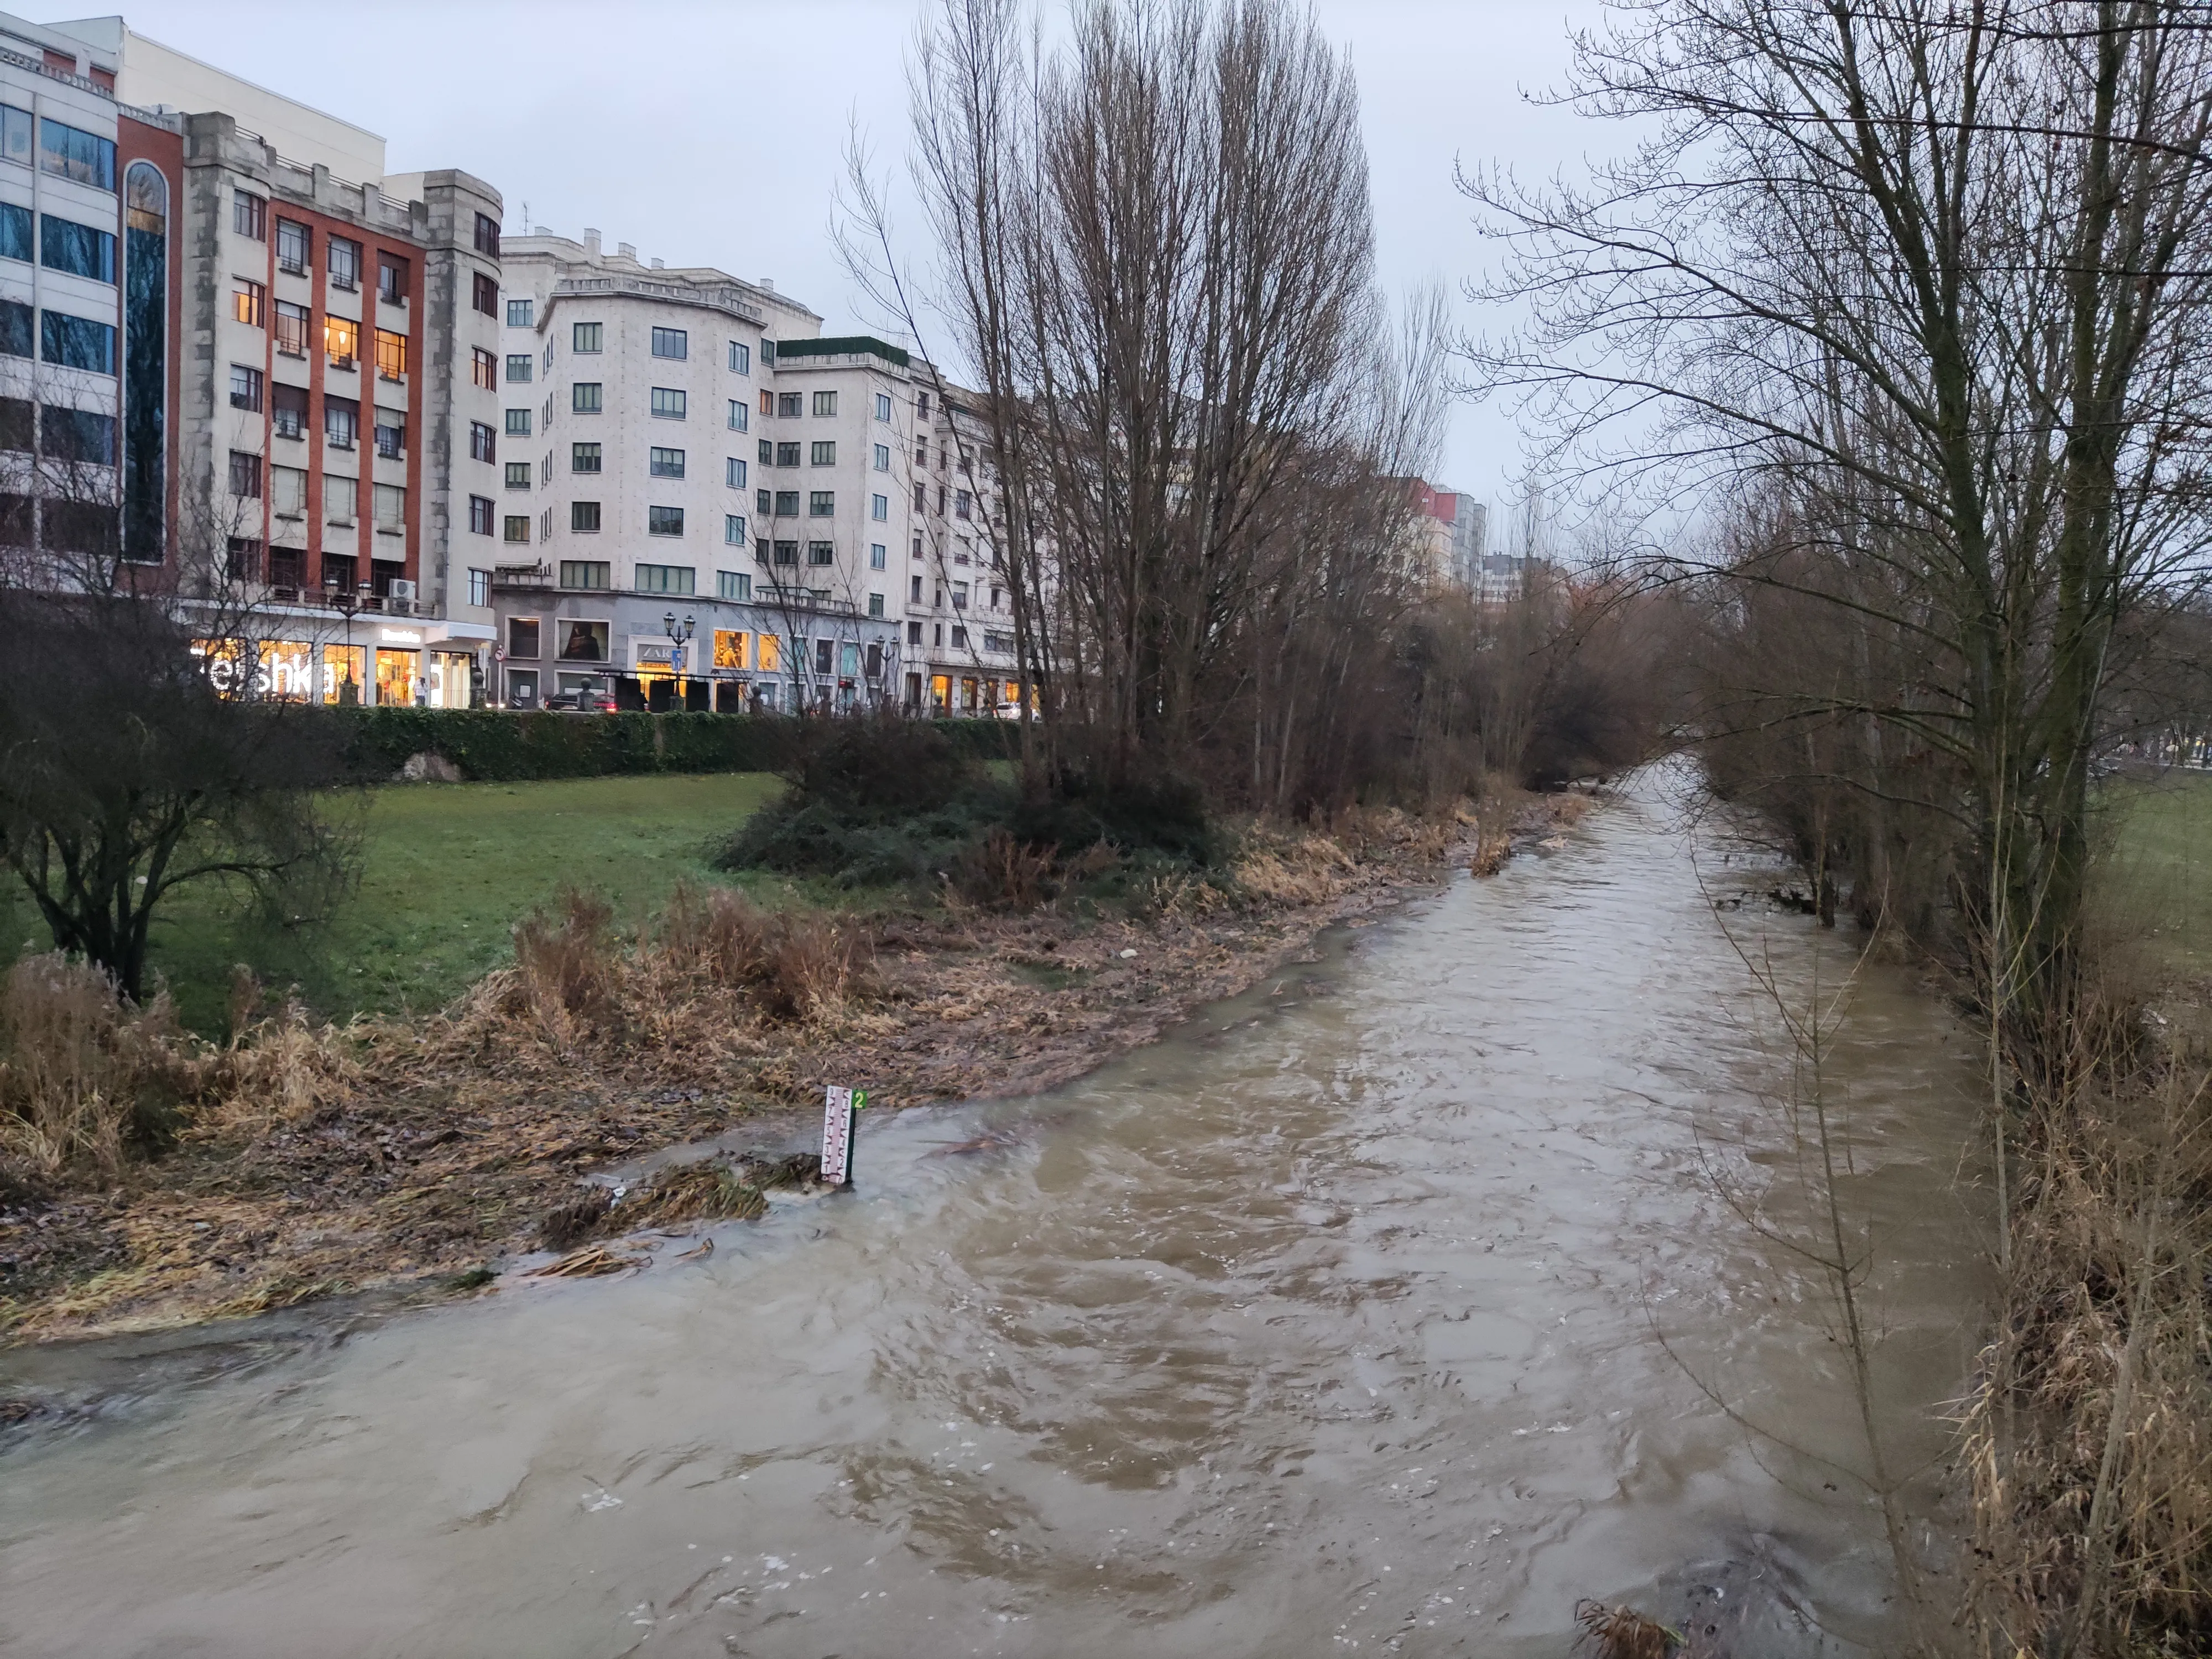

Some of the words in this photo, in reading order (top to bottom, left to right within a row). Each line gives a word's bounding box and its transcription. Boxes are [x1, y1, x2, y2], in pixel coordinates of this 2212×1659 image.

[643, 648, 671, 659] ZAR
[854, 1092, 864, 1108] 2
[828, 1106, 832, 1114] 7
[843, 1119, 847, 1128] 6
[841, 1139, 845, 1147] 4
[825, 1145, 829, 1154] 3
[840, 1158, 844, 1166] 2
[824, 1165, 828, 1173] 1
